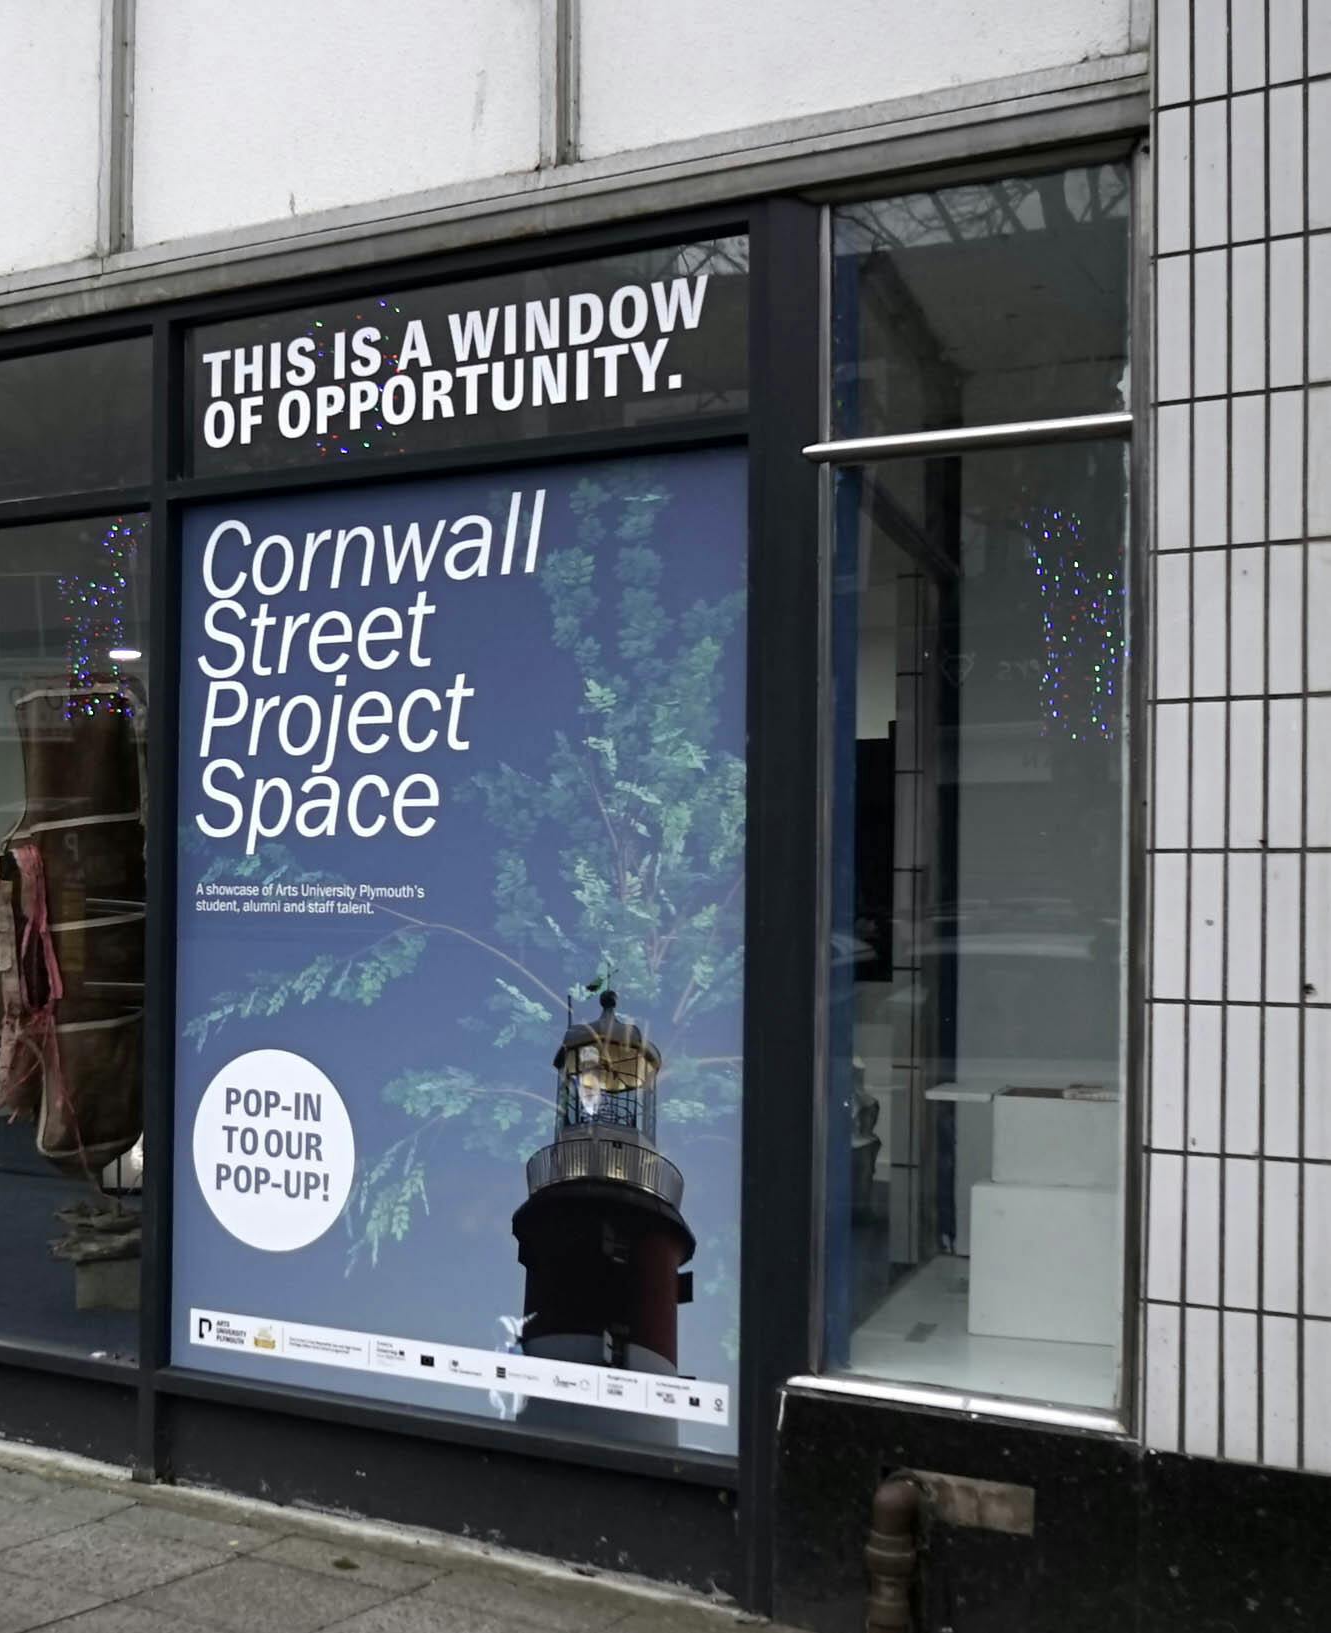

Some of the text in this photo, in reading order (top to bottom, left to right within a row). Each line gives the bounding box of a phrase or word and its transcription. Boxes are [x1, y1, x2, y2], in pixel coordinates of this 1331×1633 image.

[202, 273, 709, 398] THIS IS A WINDOW
[203, 337, 683, 449] OF OPPORTUNITY.
[202, 489, 547, 599] Cornwall
[197, 590, 437, 679] Street
[199, 673, 476, 774] Project
[195, 758, 441, 857] Space
[195, 899, 374, 915] student, alumni and staff talent.
[196, 883, 425, 900] A showcase of Arts University Plymouth's
[225, 1087, 322, 1122] POP-IN
[221, 1125, 323, 1162] TO OUR
[215, 1163, 331, 1202] POP-UP!
[216, 1320, 230, 1328] ARTS
[216, 1327, 247, 1338] UNIVERSITY
